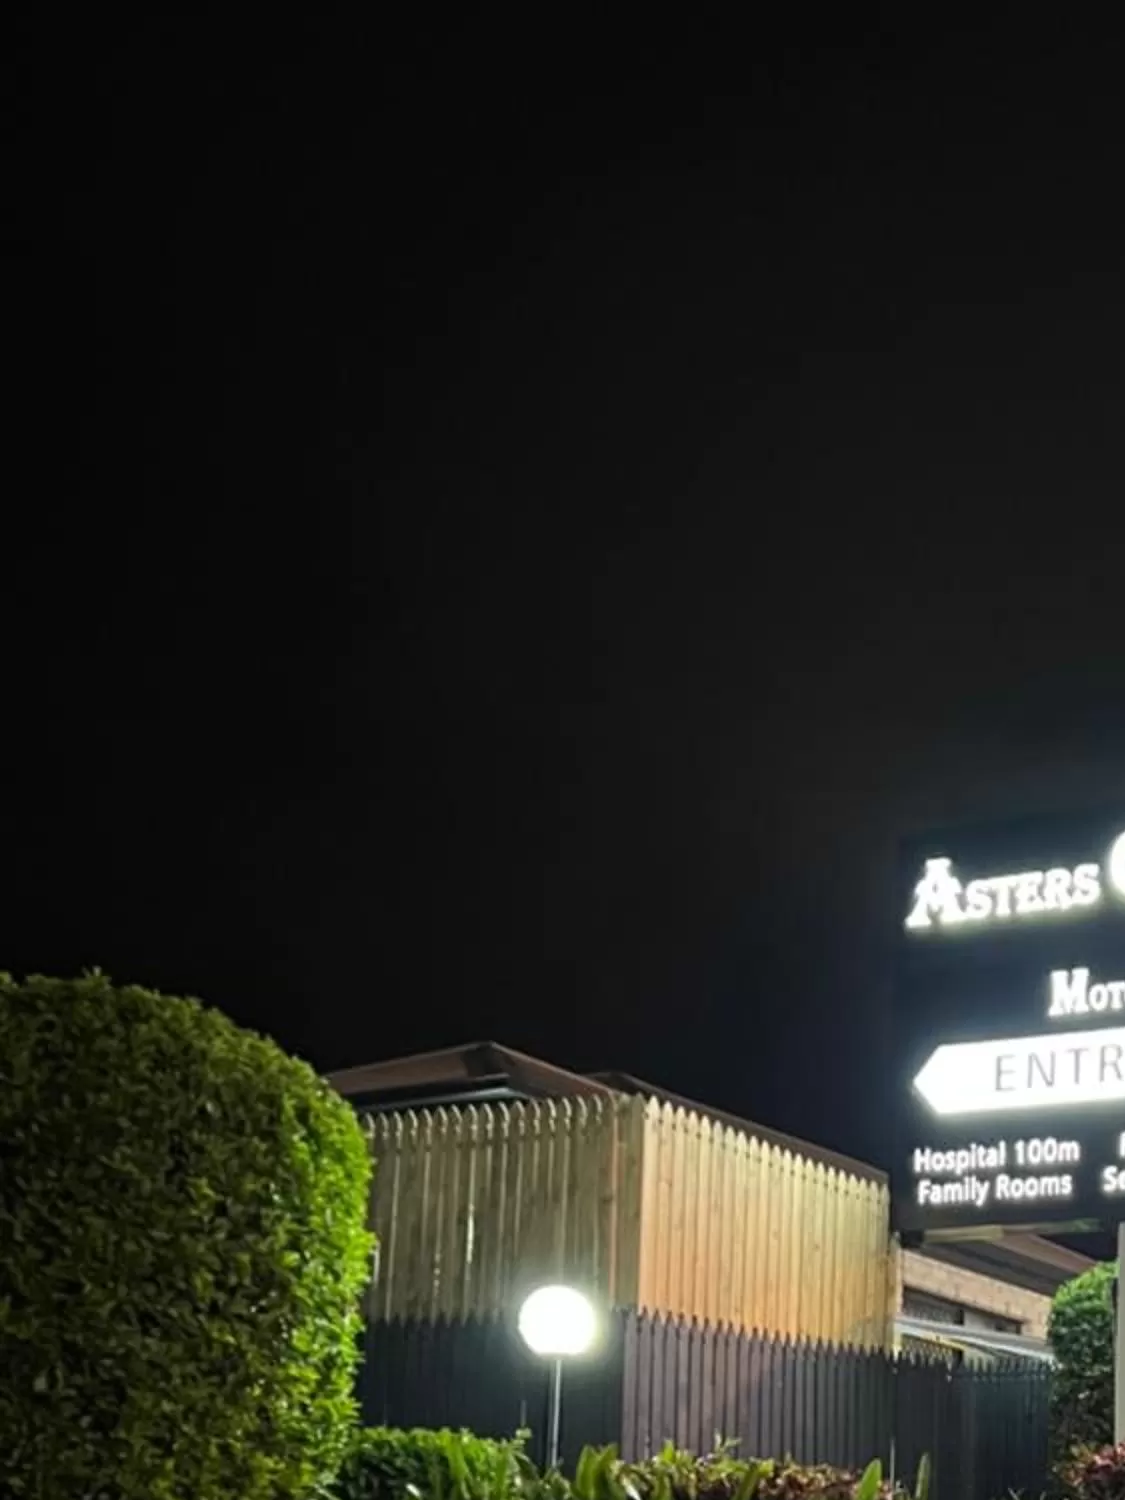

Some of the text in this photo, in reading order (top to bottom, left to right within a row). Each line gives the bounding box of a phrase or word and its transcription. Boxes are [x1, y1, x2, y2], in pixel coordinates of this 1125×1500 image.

[913, 1137, 1081, 1175] Hospital 100m
[917, 1172, 1073, 1208] Family Rooms
